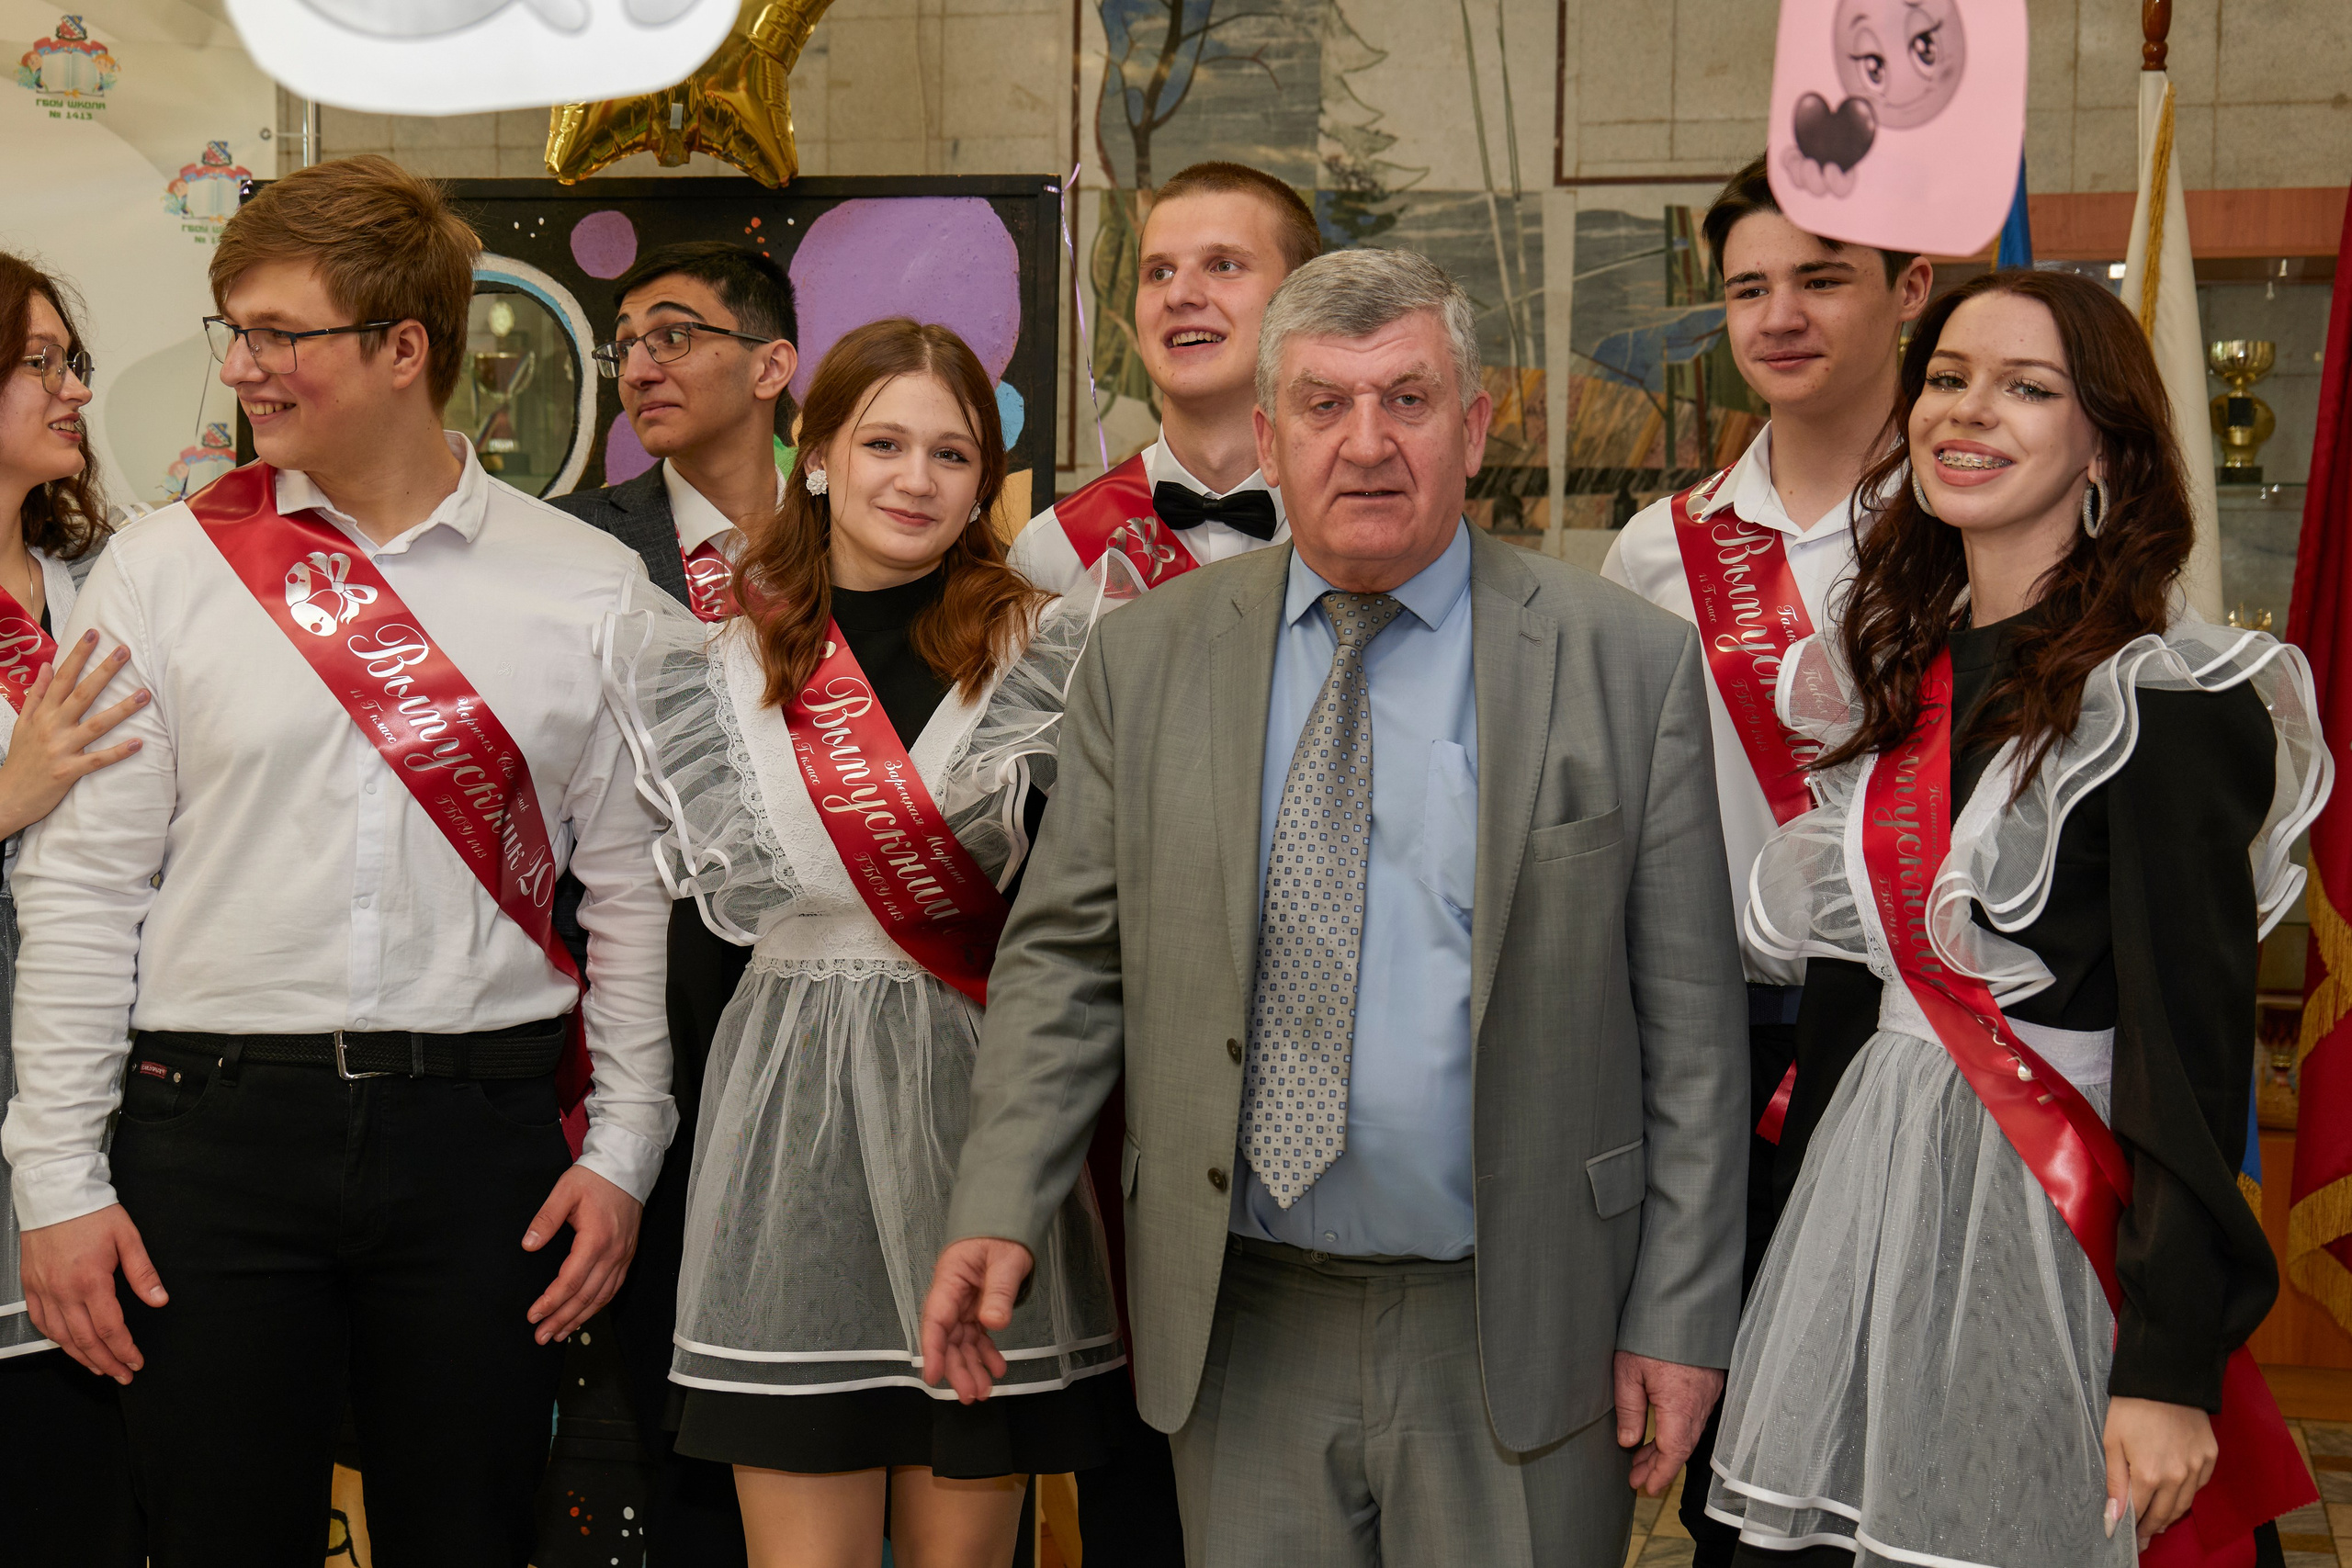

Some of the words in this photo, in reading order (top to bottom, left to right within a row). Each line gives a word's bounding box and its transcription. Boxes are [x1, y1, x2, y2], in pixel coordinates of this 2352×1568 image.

[35, 98, 63, 108] ГБОУ
[67, 99, 107, 109] ШКОЛА
[66, 111, 93, 120] 1413
[1704, 594, 1717, 625] класс
[347, 623, 526, 871] Выпускник
[369, 713, 399, 745] класс
[1730, 678, 1758, 724] ГБОУ
[1751, 725, 1768, 752] 1413
[457, 694, 496, 754] Черных
[496, 751, 530, 814] Свяслав
[799, 755, 821, 786] класс
[435, 794, 478, 848] ГБОУ
[469, 837, 488, 860] 1413
[800, 676, 962, 939] Выпускниц
[884, 760, 923, 827] Зарецкая
[922, 828, 966, 885] Марина
[1872, 678, 1951, 992] Выпускниц
[853, 852, 891, 897] ГБОУ
[883, 899, 905, 921] 1413
[1877, 873, 1898, 928] ГБОУ
